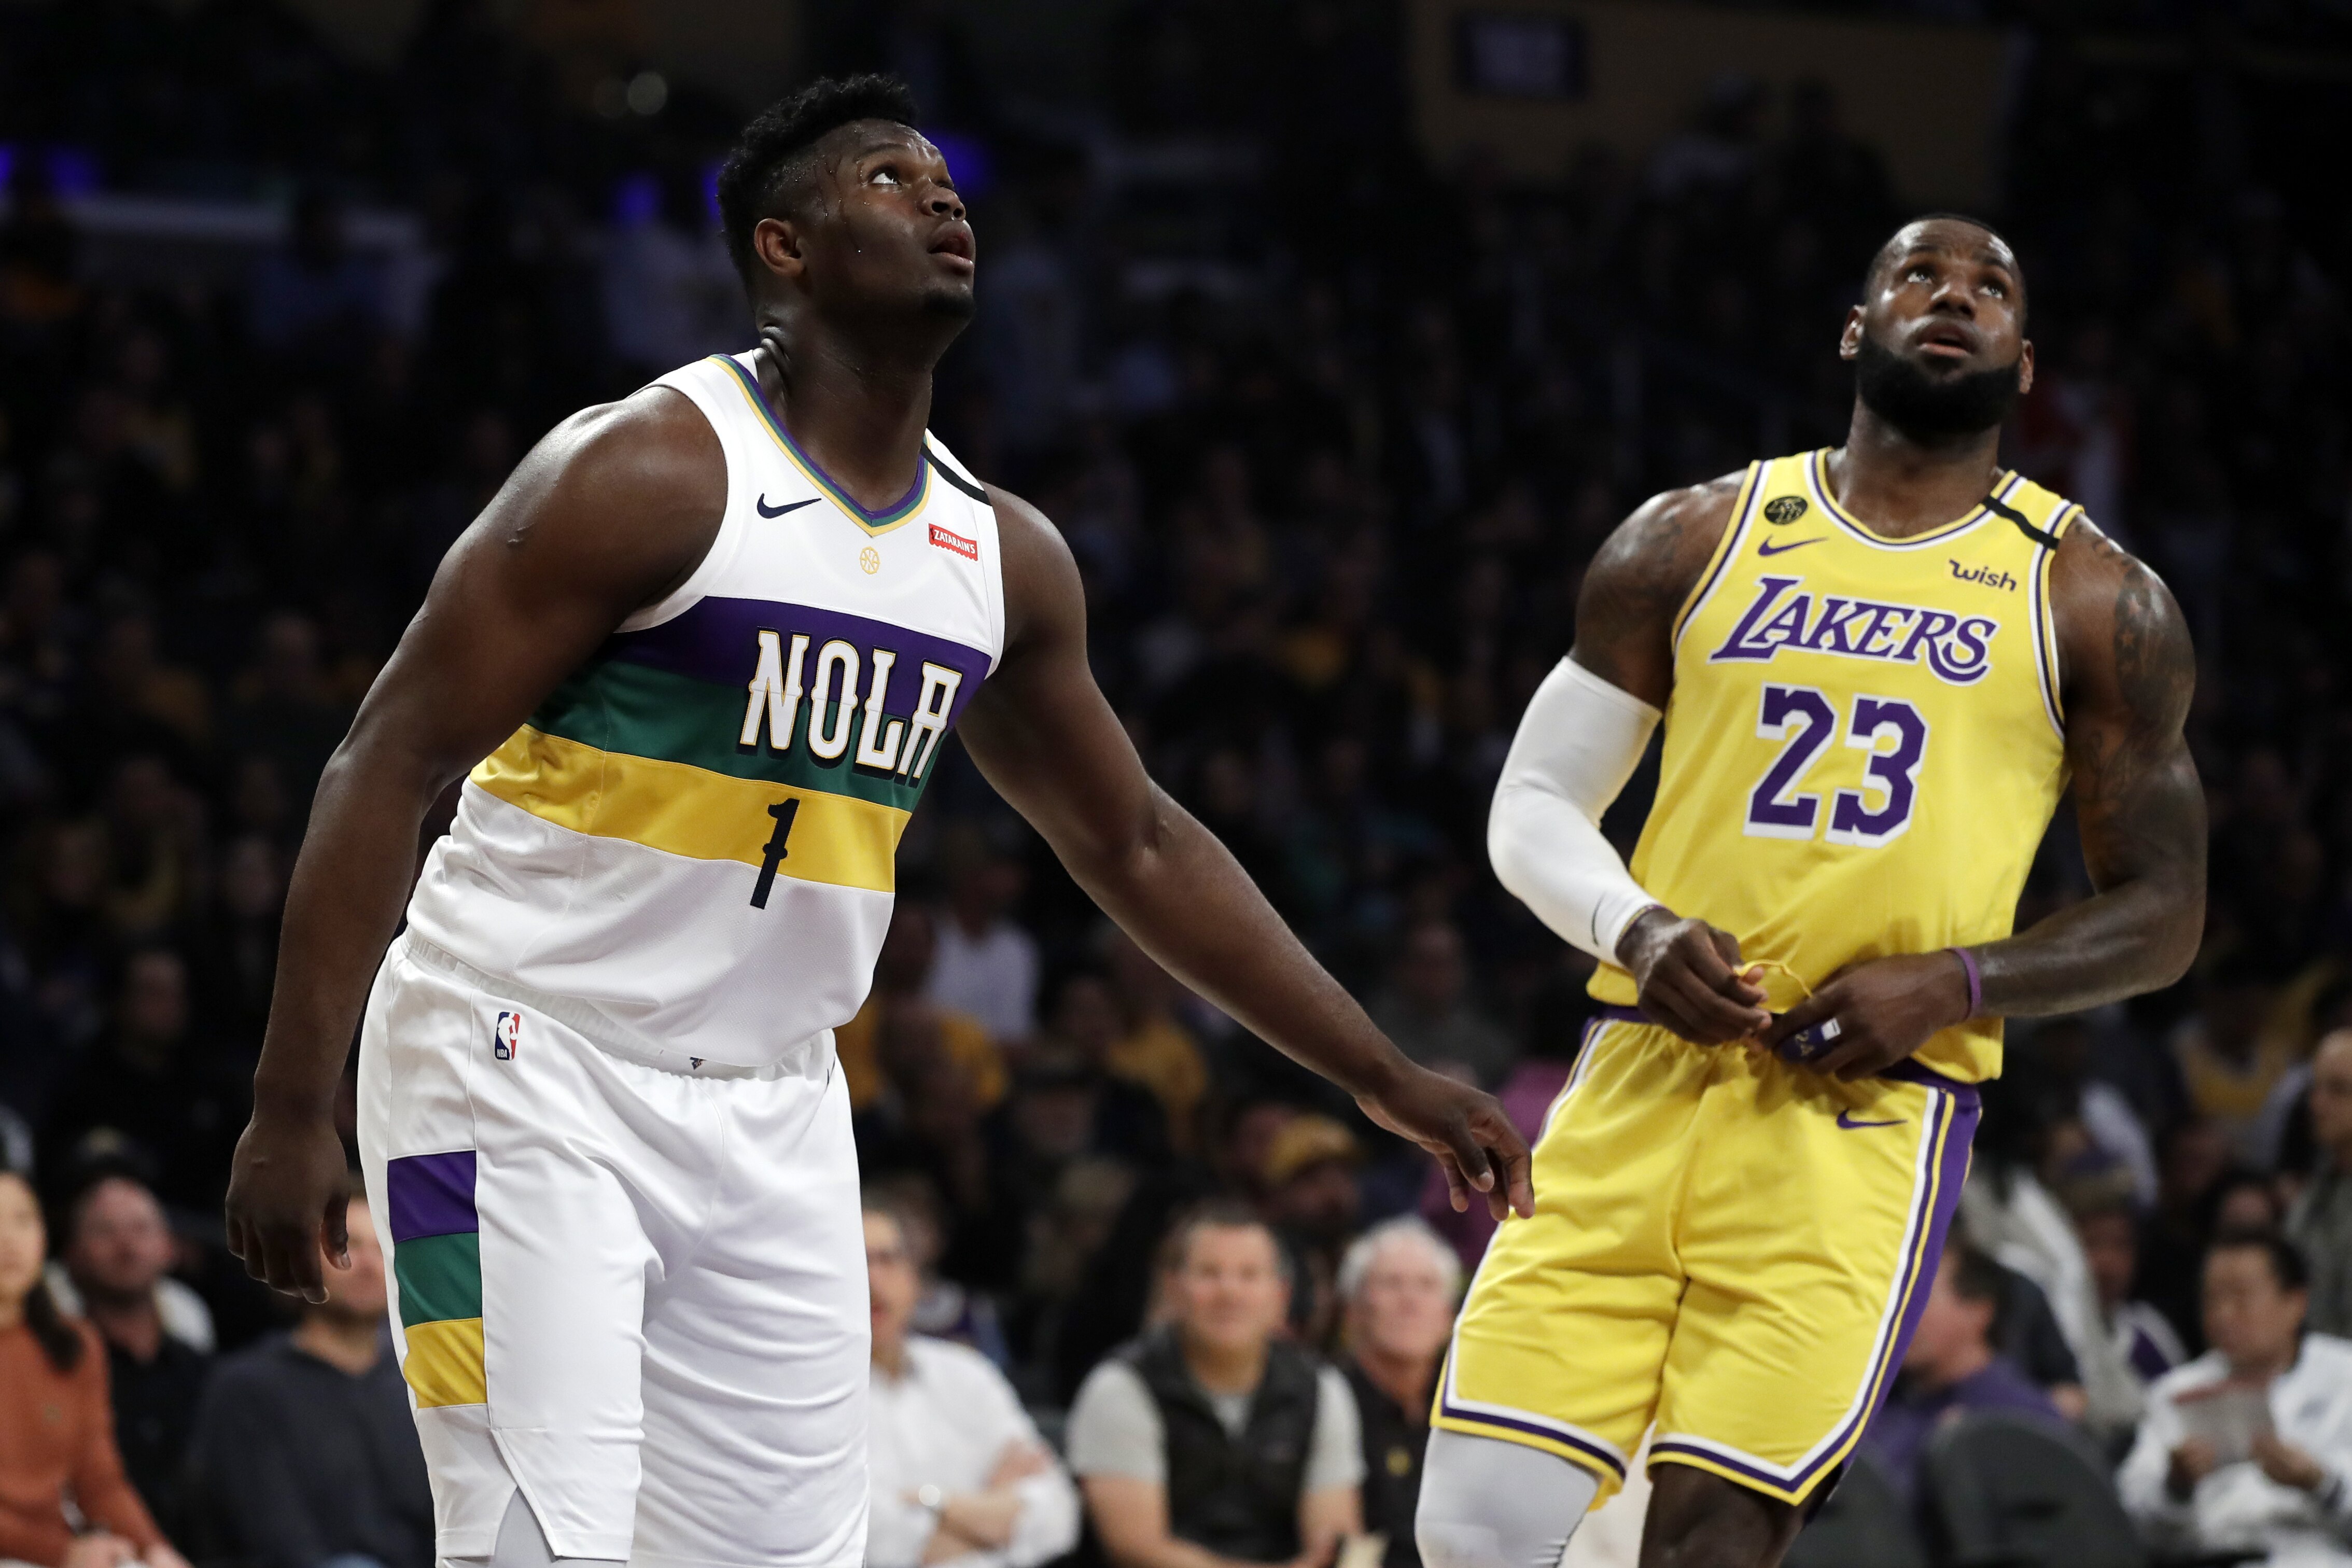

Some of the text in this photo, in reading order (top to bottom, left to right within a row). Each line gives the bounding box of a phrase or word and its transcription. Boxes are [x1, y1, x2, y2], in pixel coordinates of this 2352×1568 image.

[934, 529, 976, 554] ZATARAIN'S
[1949, 559, 2017, 591] wish
[1706, 575, 2000, 686] LAKERS
[738, 628, 963, 782] NOLA
[1743, 681, 1929, 849] 23
[750, 799, 800, 909] 1
[497, 1048, 508, 1058] NBA
